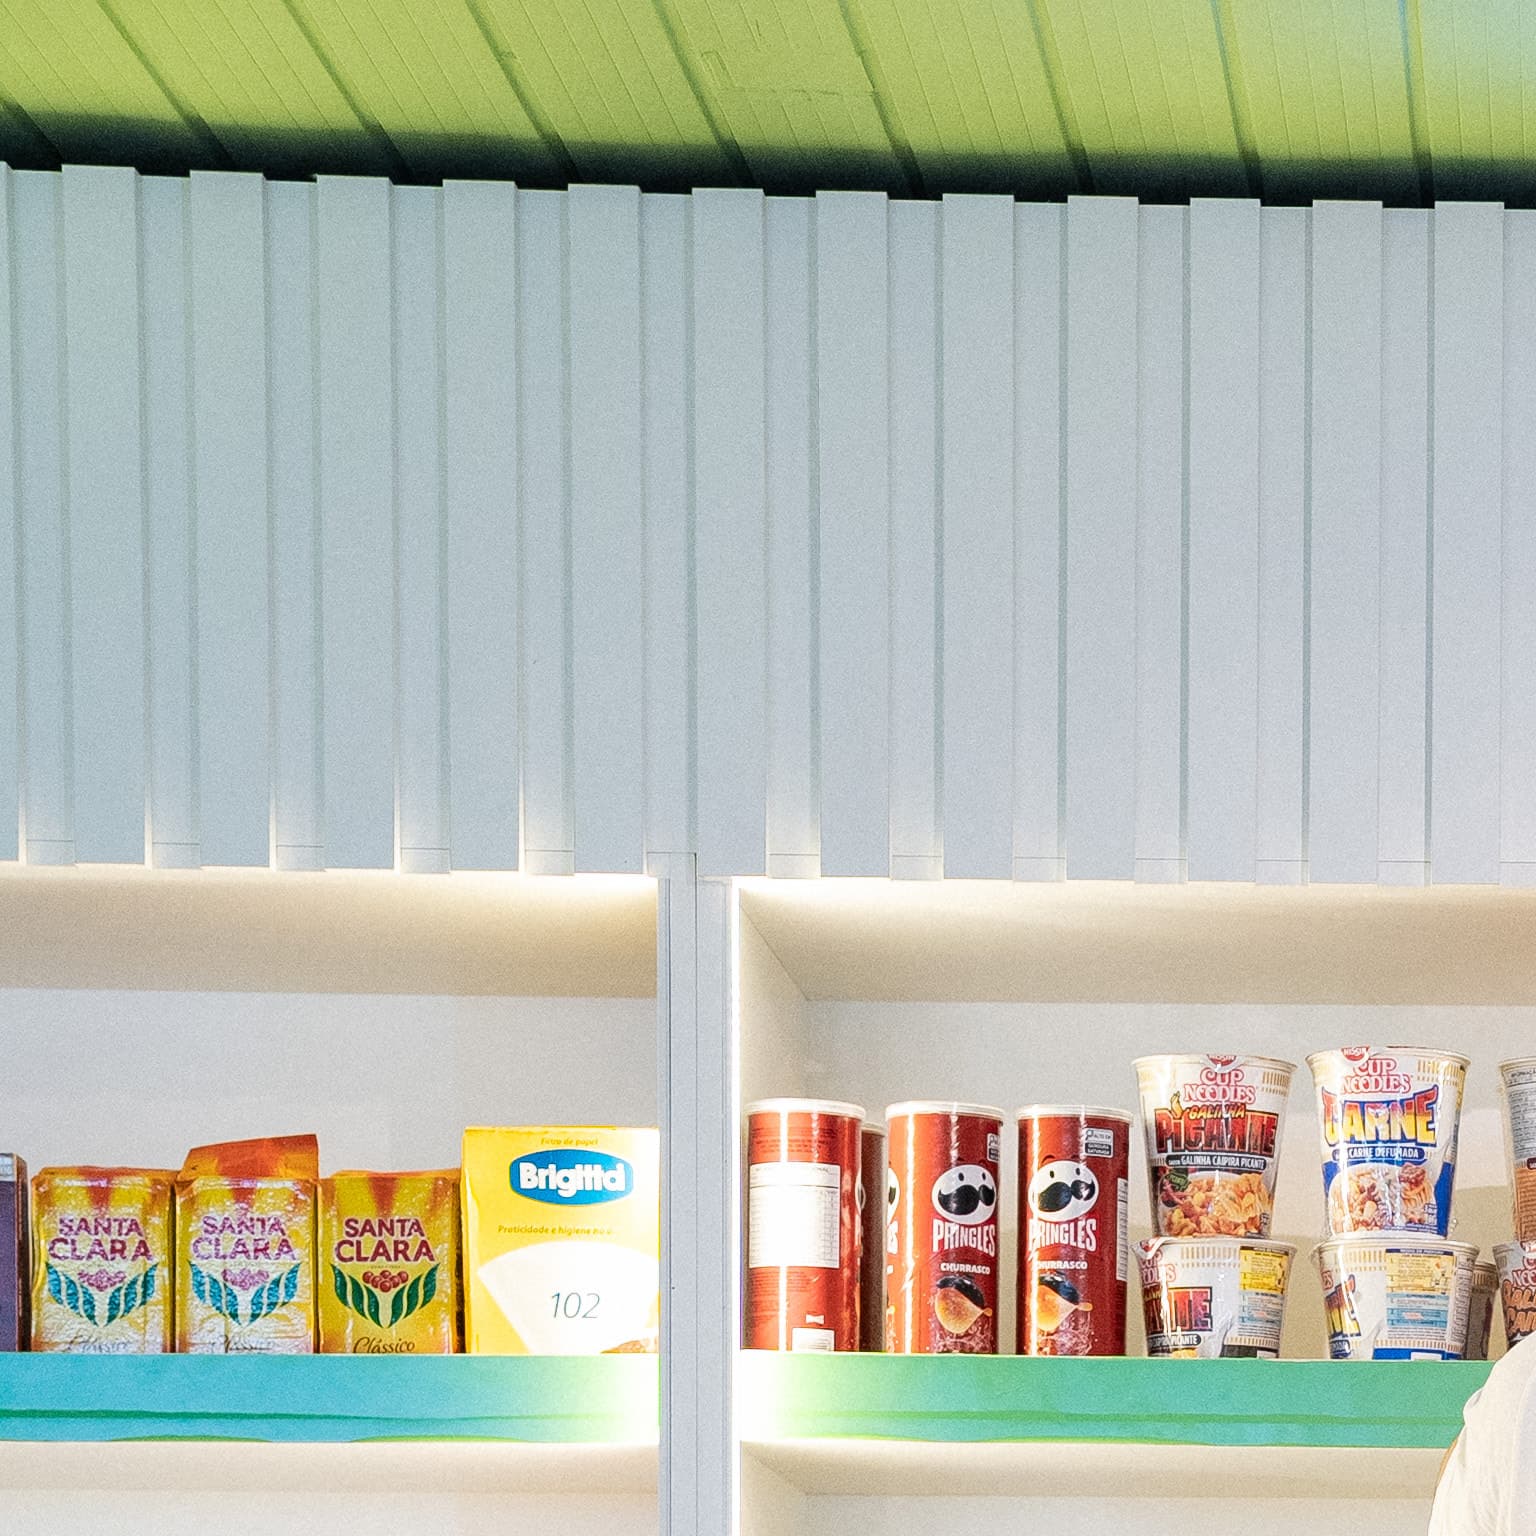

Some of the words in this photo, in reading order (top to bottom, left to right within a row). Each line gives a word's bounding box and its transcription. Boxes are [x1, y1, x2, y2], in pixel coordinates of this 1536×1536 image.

[1200, 1067, 1245, 1086] CUP
[1184, 1084, 1256, 1104] NOODLES
[59, 1216, 144, 1237] SANTA
[202, 1215, 287, 1237] SANTA
[344, 1218, 426, 1238] SANTA
[1029, 1218, 1097, 1252] PRINGLES
[933, 1218, 996, 1258] PRINGLES
[48, 1239, 153, 1261] CLARA
[192, 1238, 299, 1261] CLARA
[335, 1239, 436, 1262] CLARA
[941, 1263, 990, 1274] CHURRASCO
[550, 1291, 600, 1319] 102
